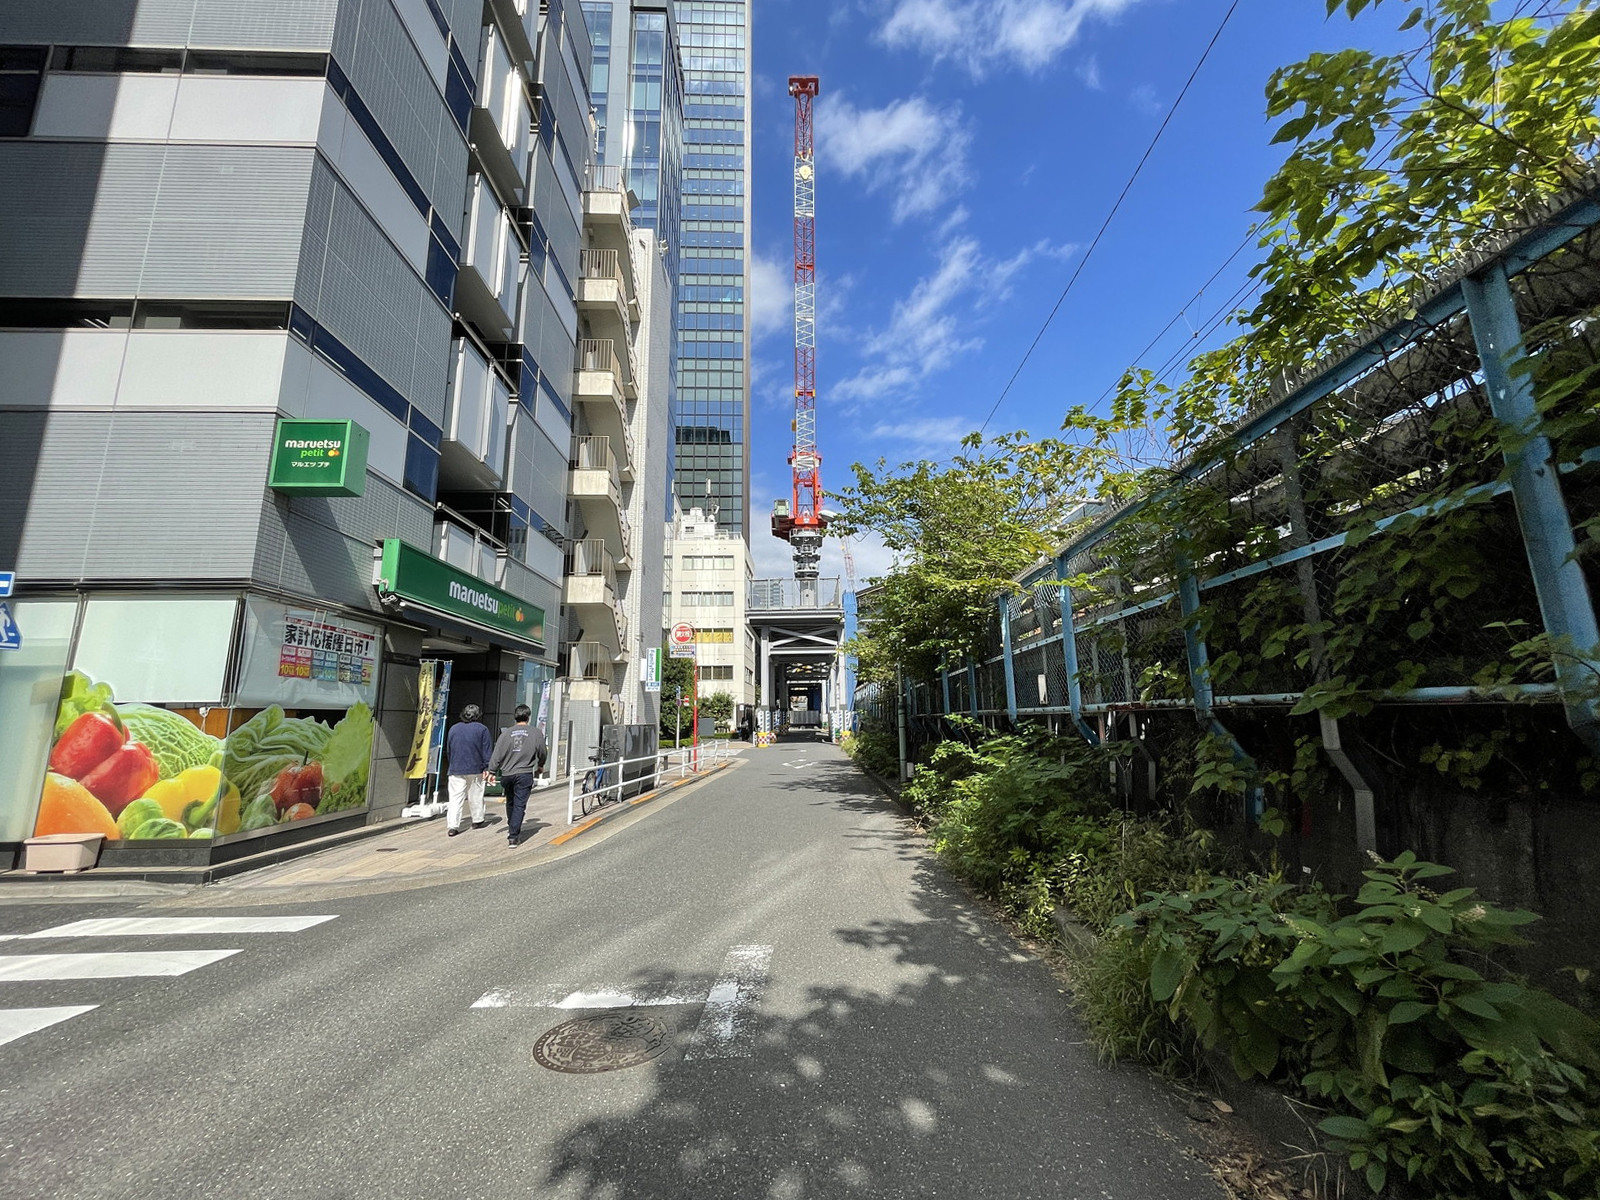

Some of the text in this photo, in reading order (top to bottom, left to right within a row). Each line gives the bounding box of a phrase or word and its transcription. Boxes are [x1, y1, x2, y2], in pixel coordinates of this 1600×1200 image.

[285, 440, 341, 449] maruetsu
[300, 449, 325, 459] petit
[449, 581, 515, 618] maruetsu petit
